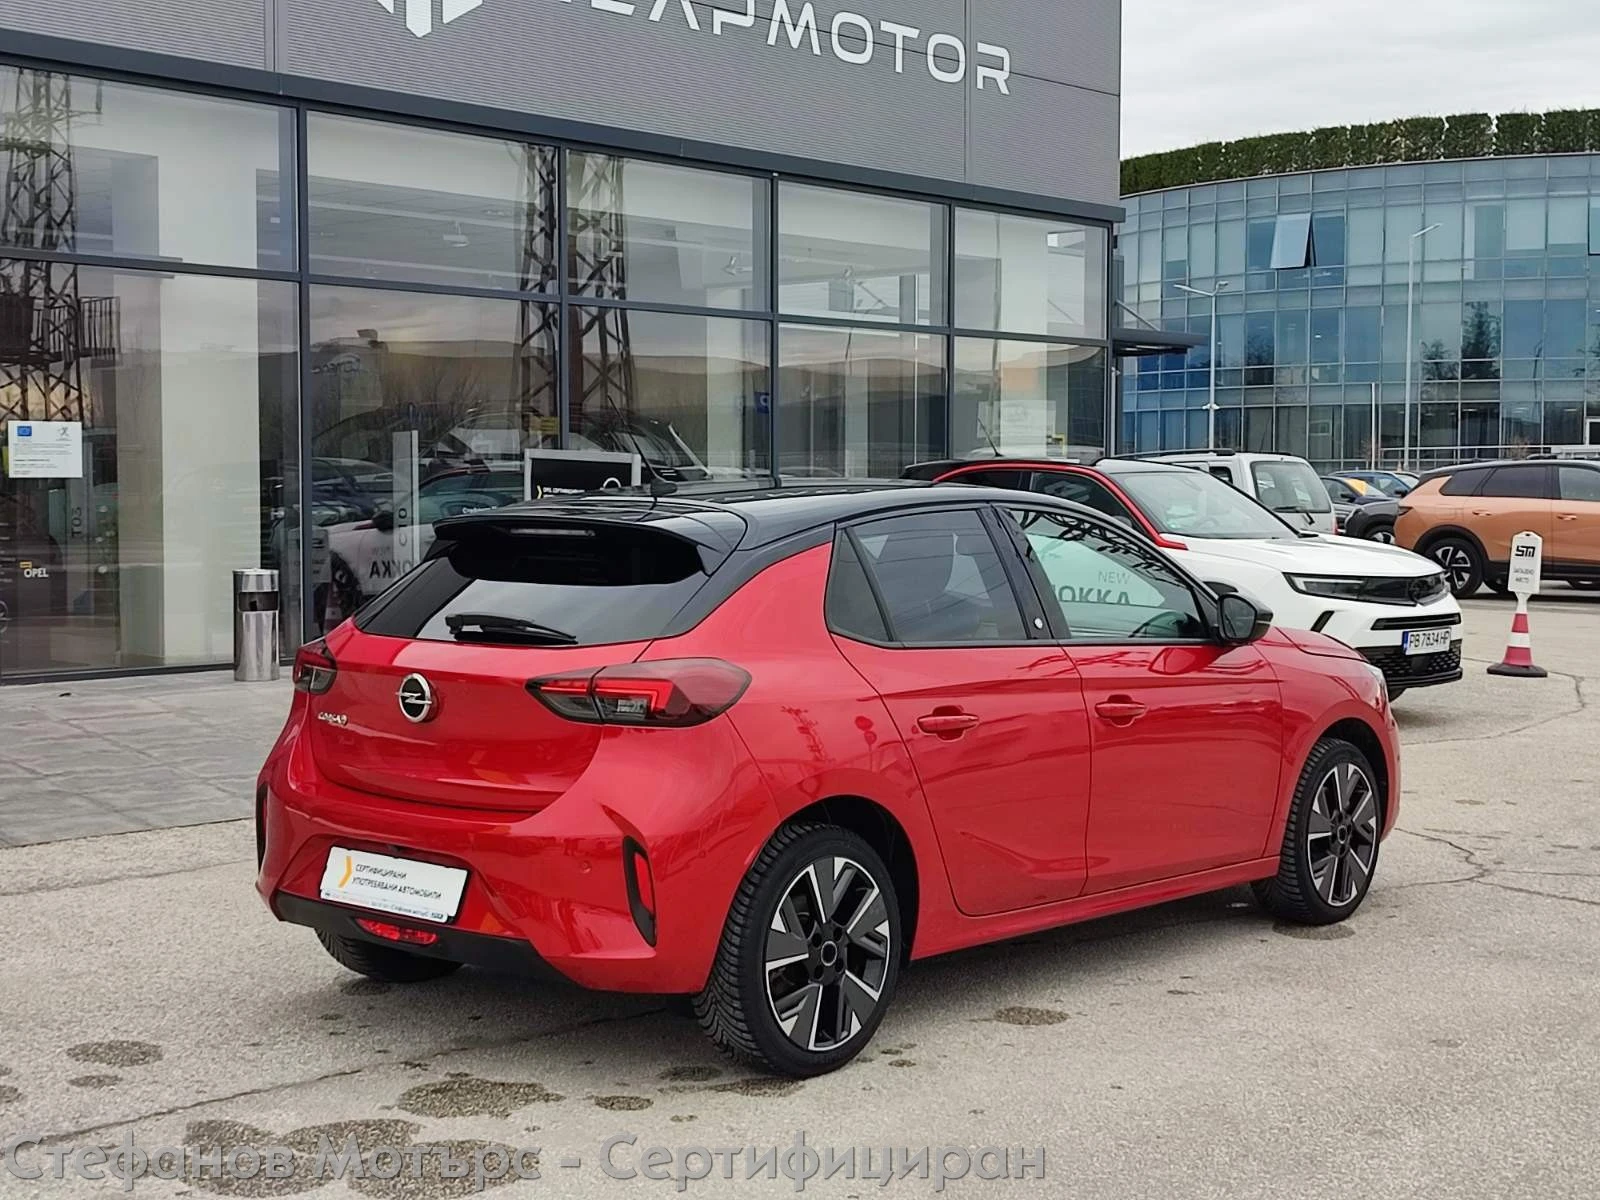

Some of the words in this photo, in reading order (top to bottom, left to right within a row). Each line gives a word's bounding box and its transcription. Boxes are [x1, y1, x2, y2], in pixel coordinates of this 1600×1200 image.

[24, 568, 49, 578] OPEL
[1098, 571, 1131, 585] NEW
[1052, 584, 1130, 604] OKKA
